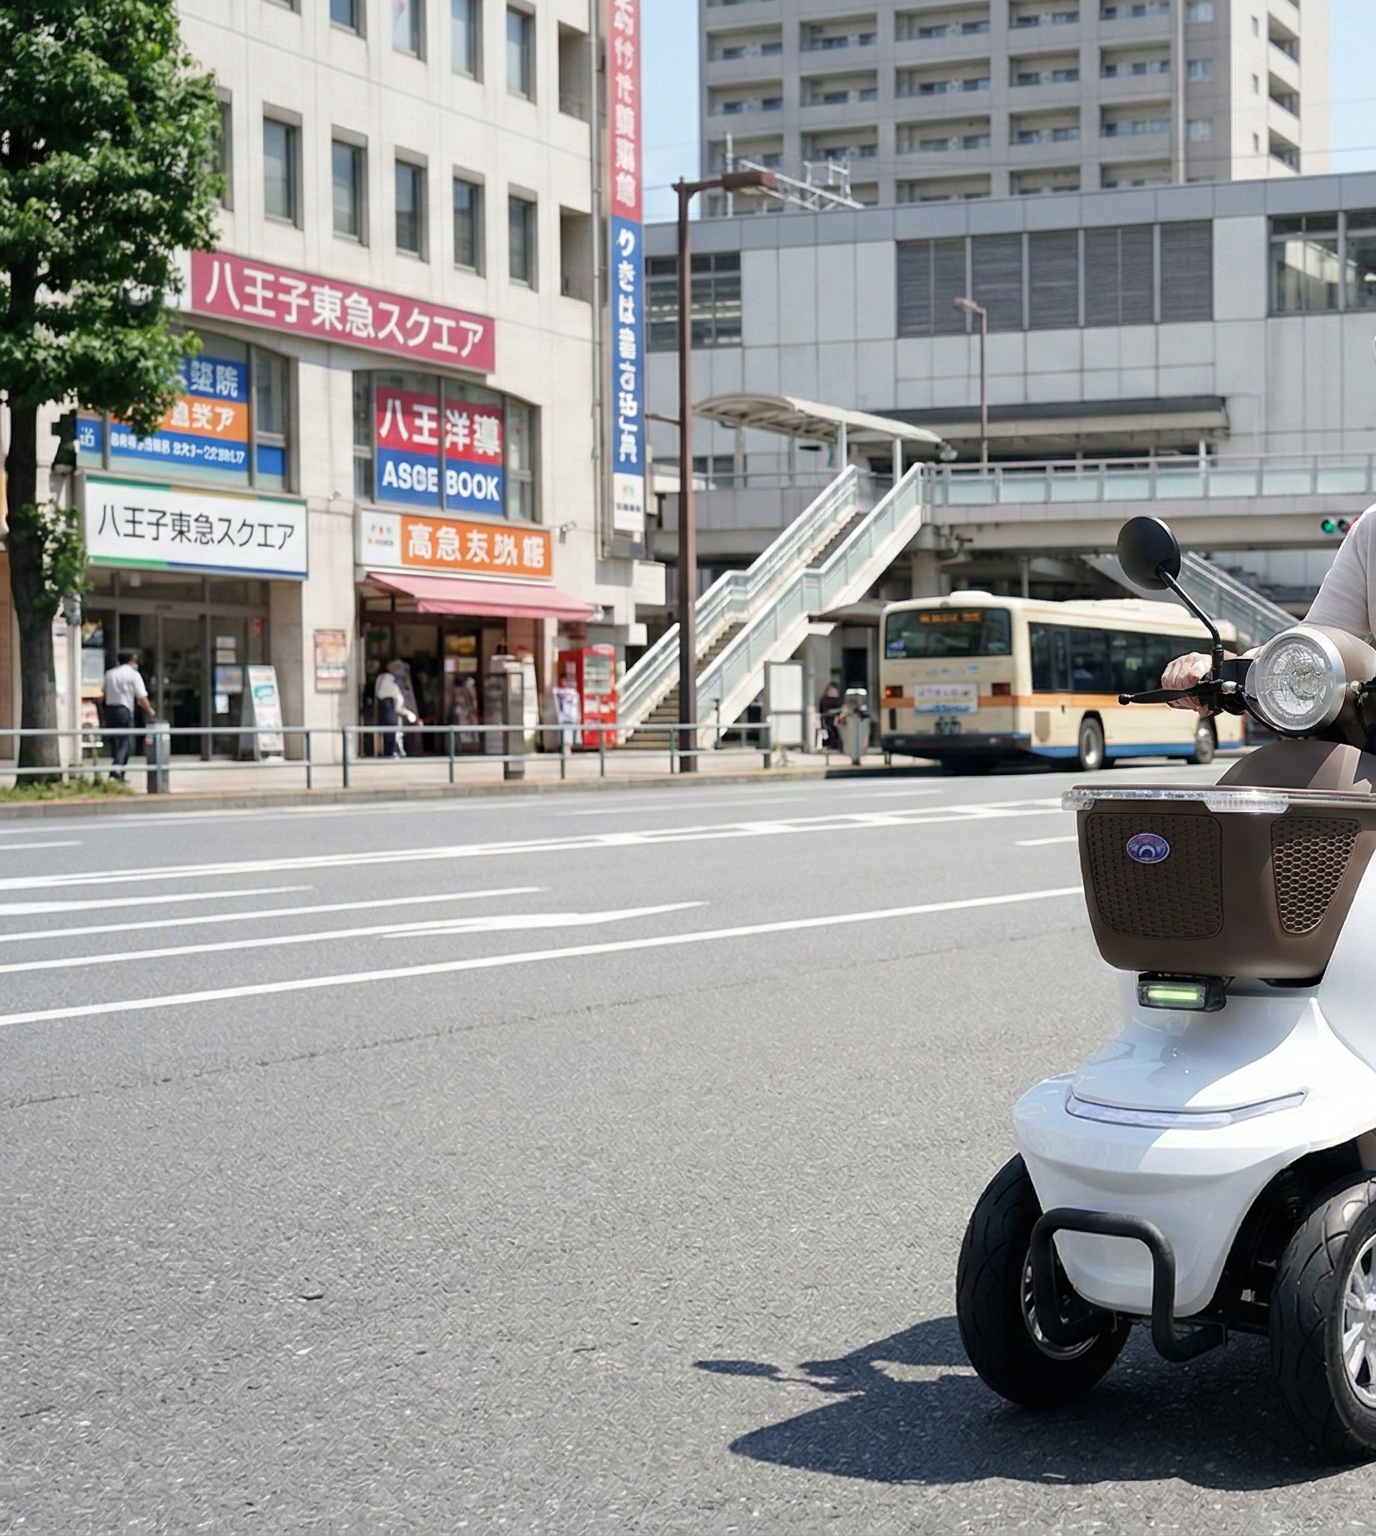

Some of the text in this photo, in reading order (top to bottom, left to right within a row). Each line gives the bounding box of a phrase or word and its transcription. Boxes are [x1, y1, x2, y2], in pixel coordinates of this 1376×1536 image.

[205, 260, 484, 358] 八王子東急スクエア
[445, 469, 500, 501] BOOK
[98, 503, 295, 550] 八王子東急スクエア
